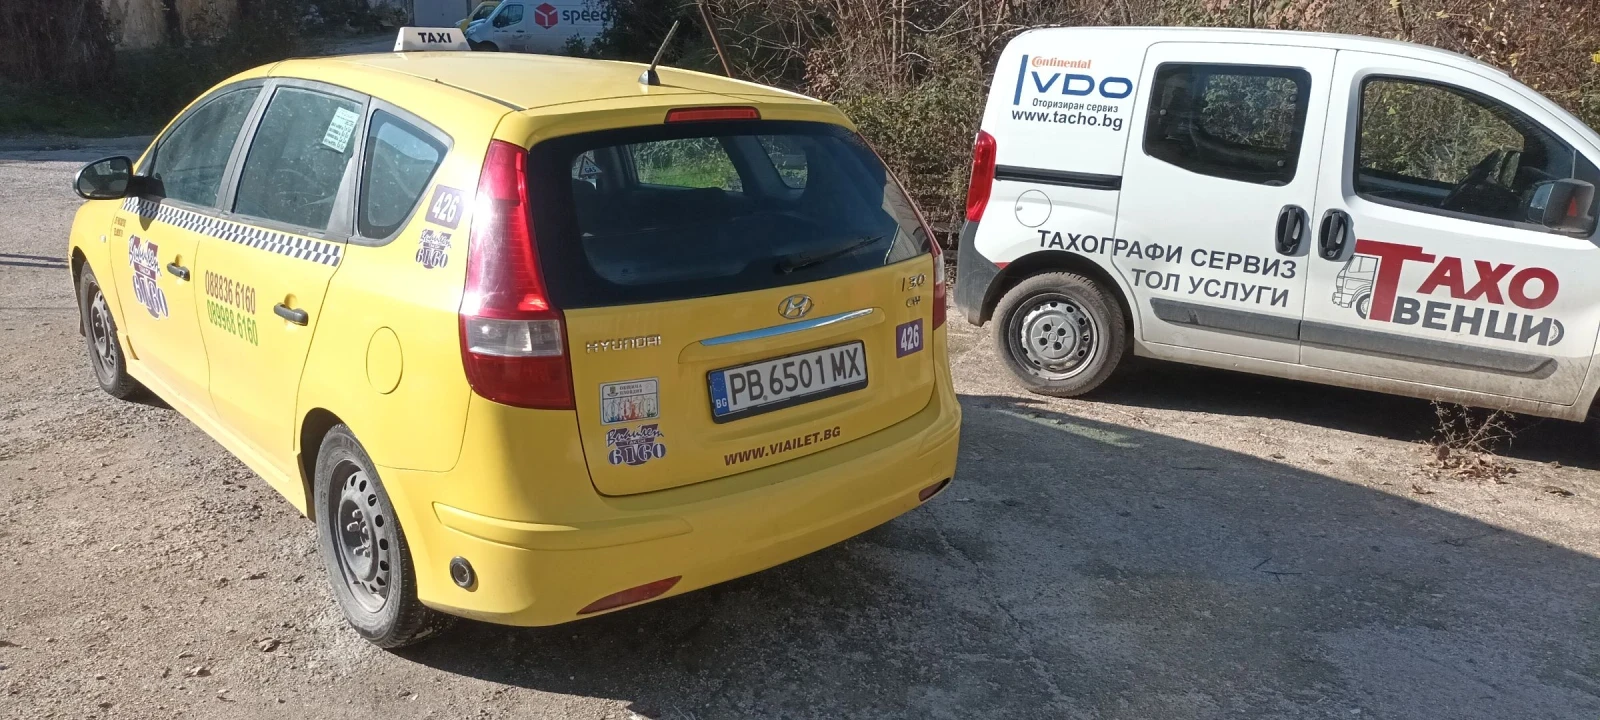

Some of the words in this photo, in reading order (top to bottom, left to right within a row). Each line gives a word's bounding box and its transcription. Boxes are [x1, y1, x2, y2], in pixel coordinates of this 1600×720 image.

[418, 32, 453, 44] TAXI
[1031, 56, 1092, 69] Continental
[1031, 71, 1133, 99] VDO
[1012, 109, 1123, 131] www.tacho.bg
[1032, 97, 1084, 111] Оторизиран
[1086, 103, 1119, 113] сервиз
[431, 191, 460, 223] 426
[415, 248, 449, 268] 6160
[1037, 230, 1183, 264] ТАХОГРАФИ
[1190, 248, 1297, 279] СЕРВИЗ
[133, 275, 168, 318] 6160
[205, 270, 233, 305] 088836
[235, 282, 256, 315] 6160
[1131, 268, 1181, 293] ТОЛ
[1187, 276, 1289, 308] УСЛУГИ
[1355, 239, 1559, 323] ТАХО
[207, 299, 236, 335] 089988
[237, 312, 259, 347] 6160
[901, 324, 920, 351] 426
[1392, 296, 1553, 347] ВЕНЦИ
[586, 335, 661, 354] HYUNDAI
[715, 397, 728, 409] BG
[729, 369, 764, 405] PB
[769, 355, 826, 395] 6501
[831, 347, 862, 382] MX
[608, 443, 666, 465] 6160
[724, 426, 841, 466] WWW.VIAILET.BG
